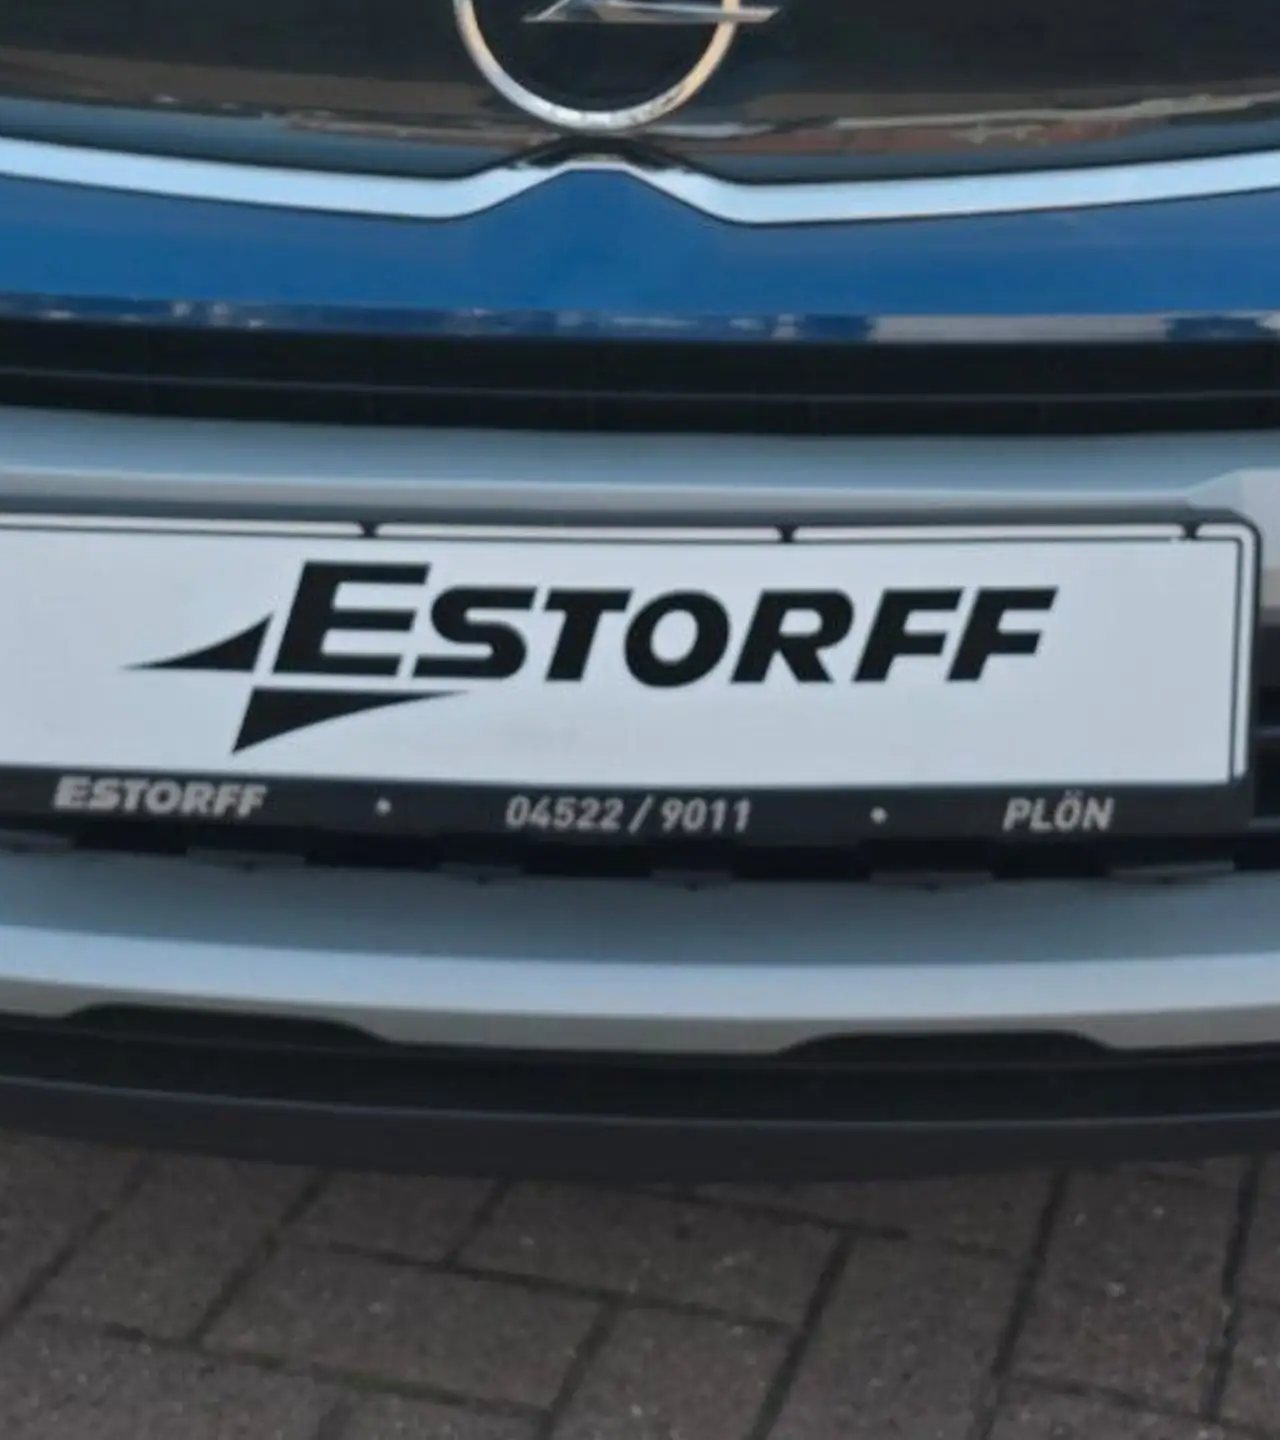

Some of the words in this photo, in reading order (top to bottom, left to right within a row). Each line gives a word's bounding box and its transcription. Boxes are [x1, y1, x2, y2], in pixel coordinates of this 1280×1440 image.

[272, 561, 1058, 688] ESTORFF
[53, 775, 268, 818] ESTORFF
[1002, 789, 1115, 832] PLÖN
